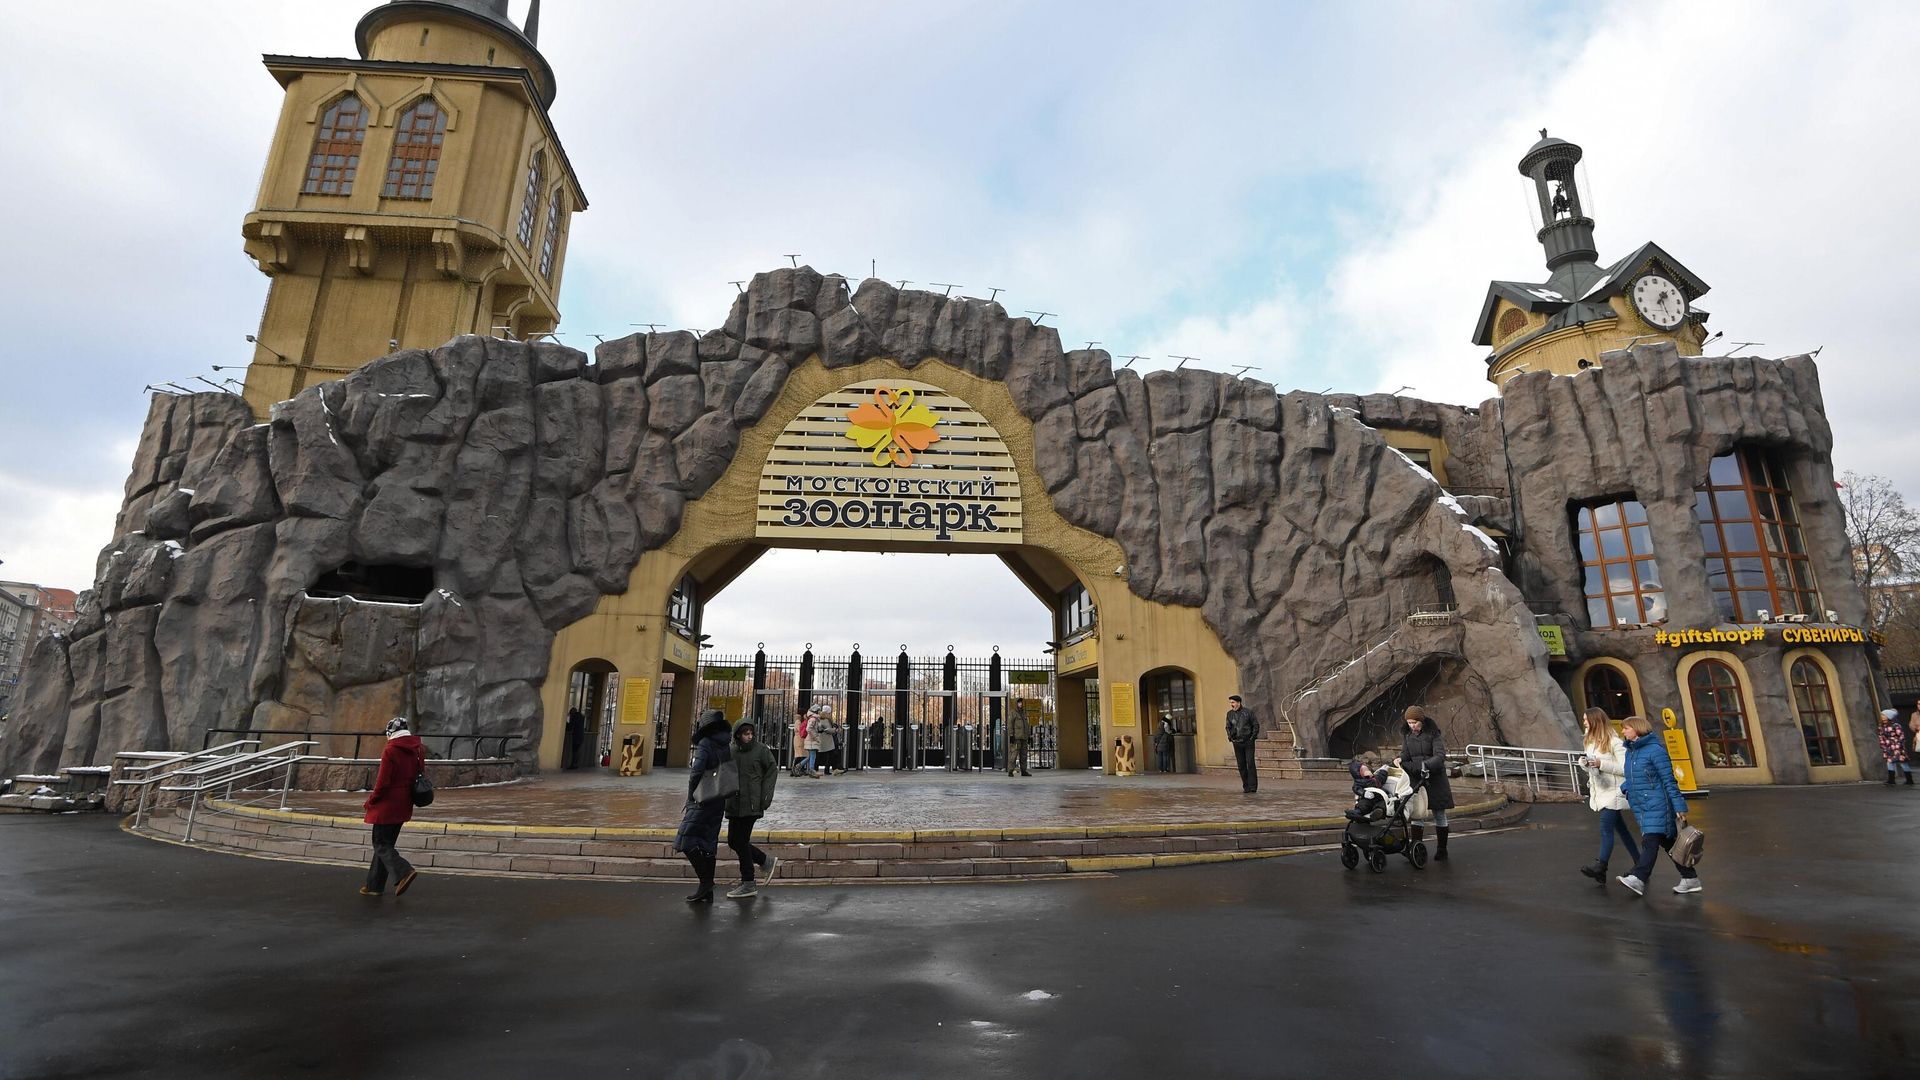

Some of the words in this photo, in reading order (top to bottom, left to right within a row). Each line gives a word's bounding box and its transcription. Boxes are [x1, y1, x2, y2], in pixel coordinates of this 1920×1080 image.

[786, 475, 996, 496] МОСКОВСКИЙ
[1655, 626, 1765, 647] #giftshop#
[1782, 627, 1864, 643] СУВЕНИРЫ
